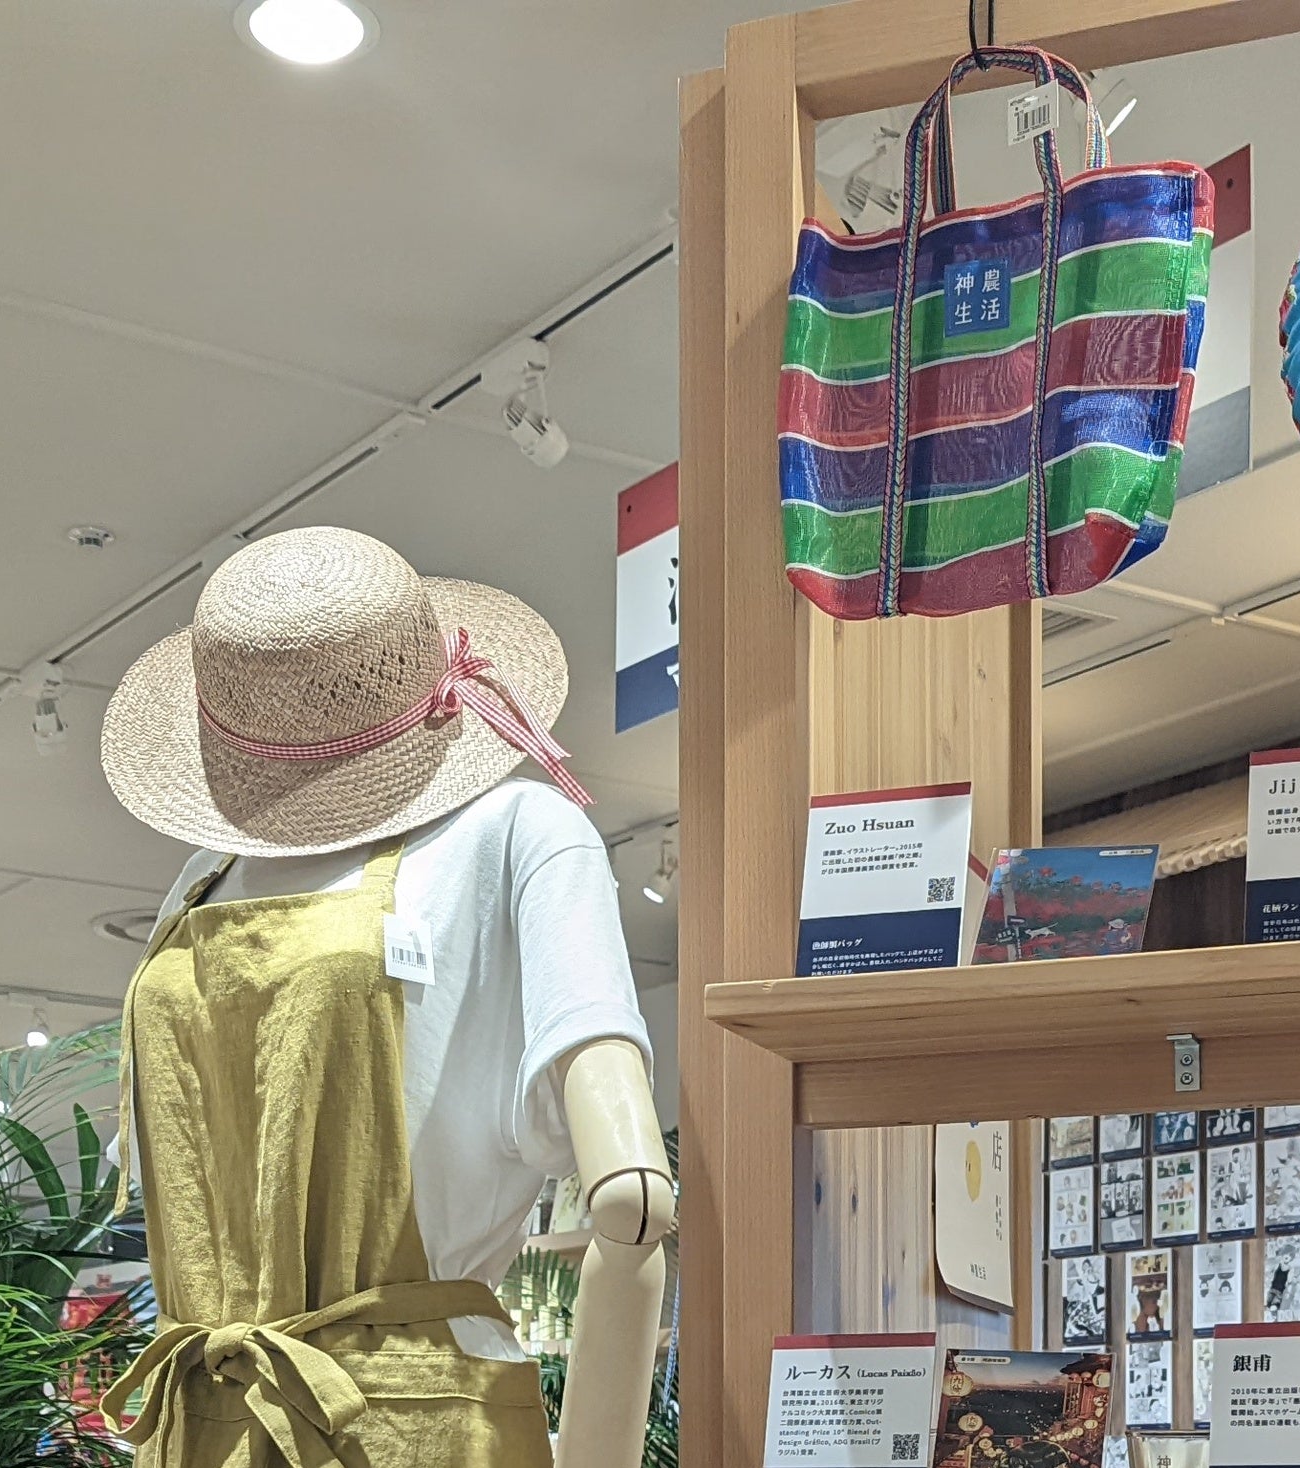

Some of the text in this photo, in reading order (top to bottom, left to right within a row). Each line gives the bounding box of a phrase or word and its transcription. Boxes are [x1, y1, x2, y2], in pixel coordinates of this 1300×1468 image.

[953, 266, 1001, 296] 神農
[953, 297, 1001, 326] 生活
[824, 818, 915, 835] Zuo Hsuan
[784, 1362, 852, 1382] ルーカス
[1232, 1353, 1273, 1373] 銀甫
